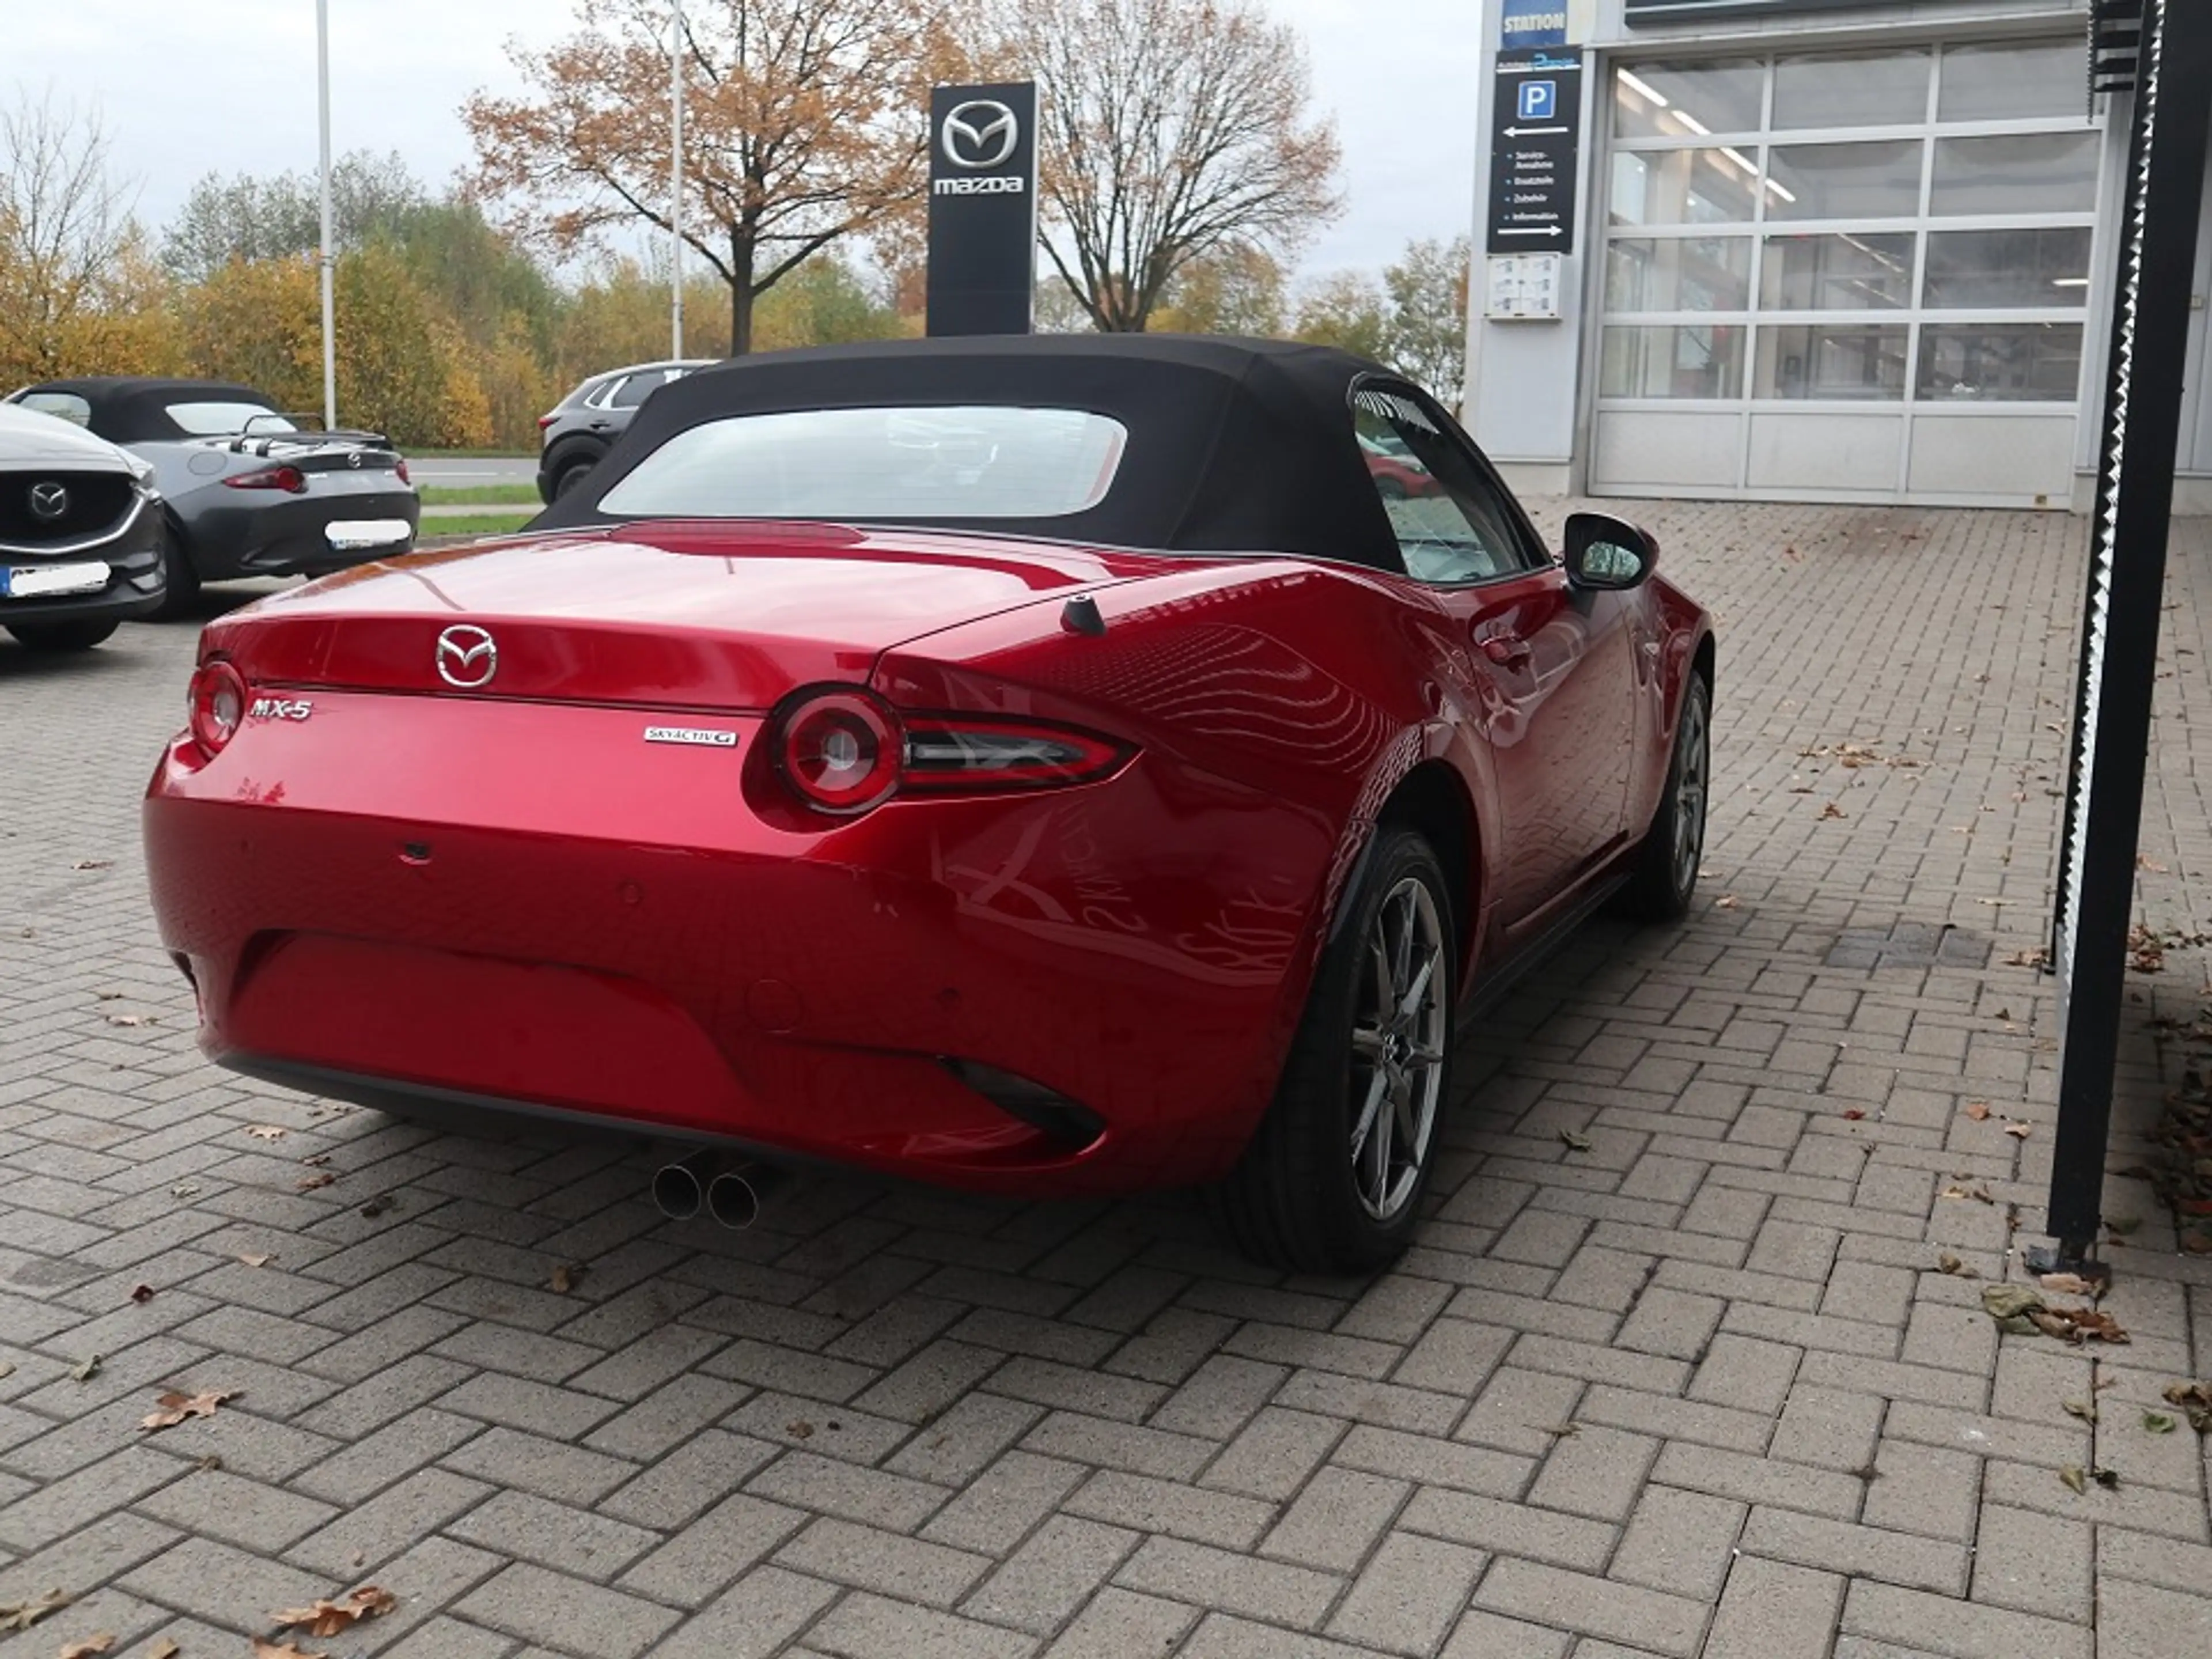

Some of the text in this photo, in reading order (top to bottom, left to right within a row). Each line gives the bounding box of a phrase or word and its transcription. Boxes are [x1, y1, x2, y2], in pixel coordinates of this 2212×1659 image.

[1504, 12, 1565, 33] STATION
[1527, 87, 1547, 114] P
[934, 176, 1024, 195] mazda
[251, 699, 312, 719] MX-5
